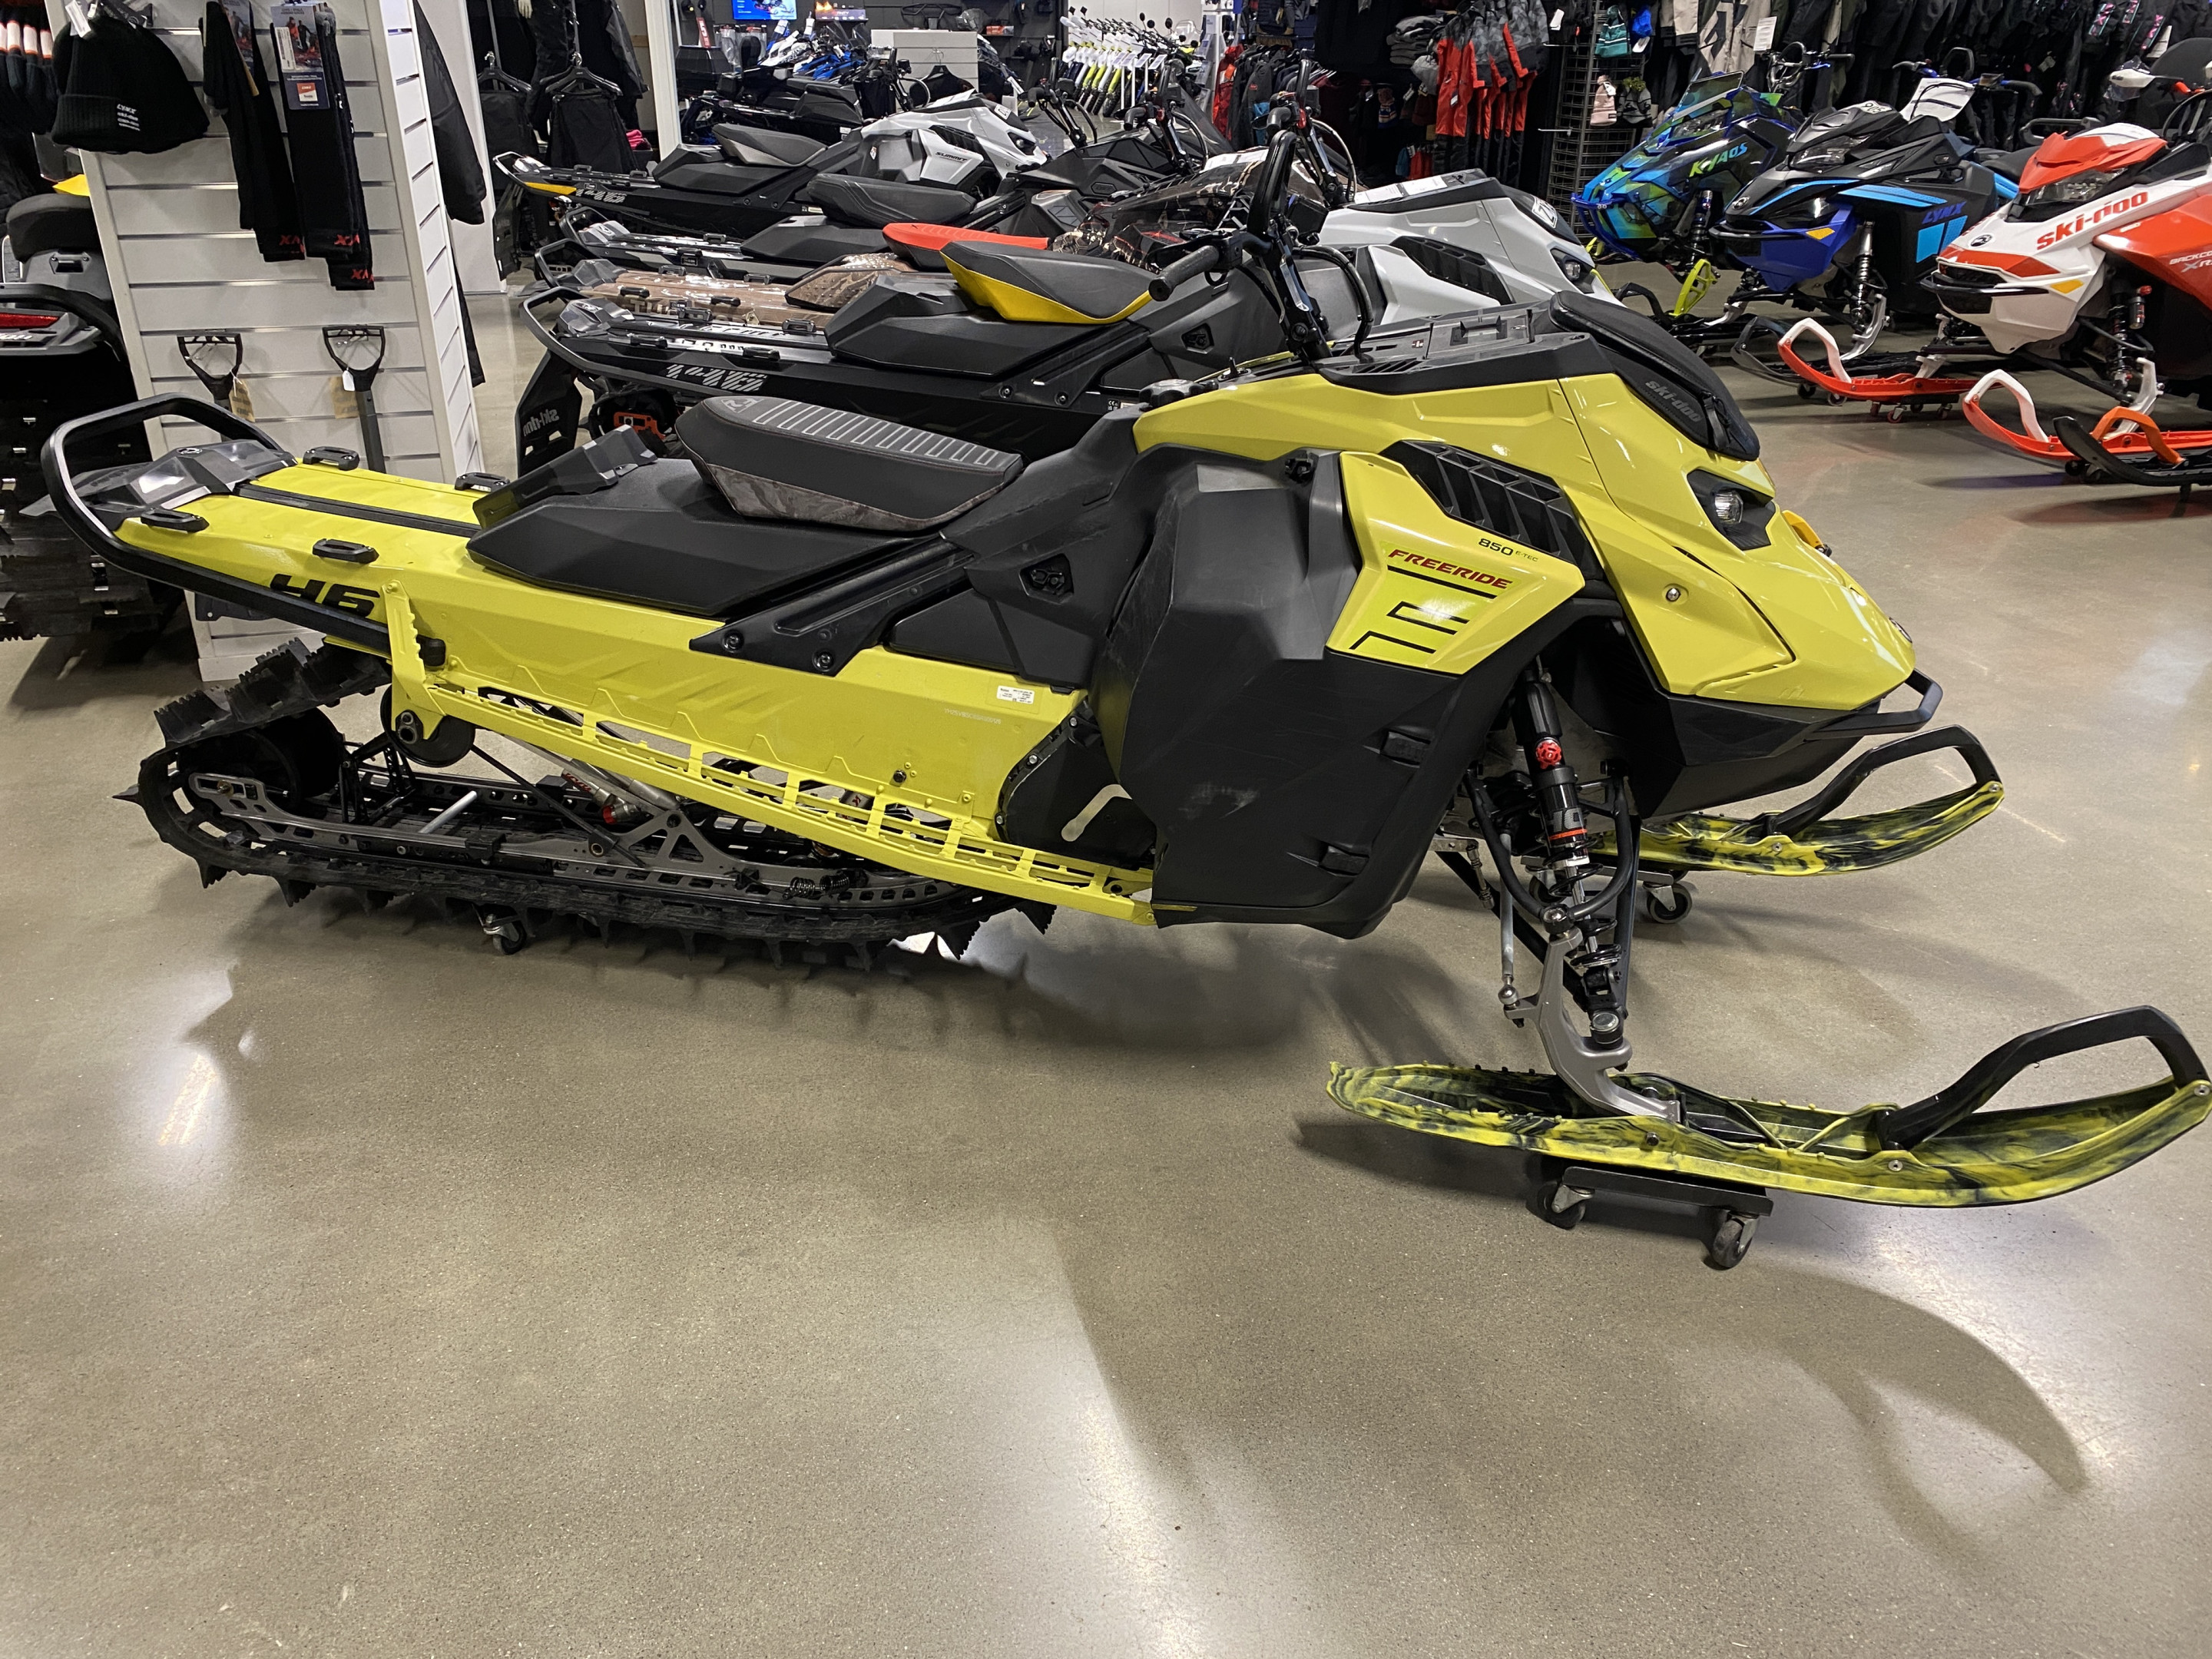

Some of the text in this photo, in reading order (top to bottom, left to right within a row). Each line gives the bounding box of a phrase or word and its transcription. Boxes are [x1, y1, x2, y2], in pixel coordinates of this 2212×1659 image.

[935, 152, 968, 161] SUMMIT
[1689, 141, 1748, 177] KHAOS
[1922, 200, 1966, 224] LYNX
[2036, 191, 2148, 250] ski-doo
[666, 364, 767, 392] 146
[1645, 380, 1703, 422] ski-doo
[1478, 538, 1538, 562] 850 E-TEC
[1388, 548, 1513, 589] FREERIDE
[270, 574, 380, 618] 46
